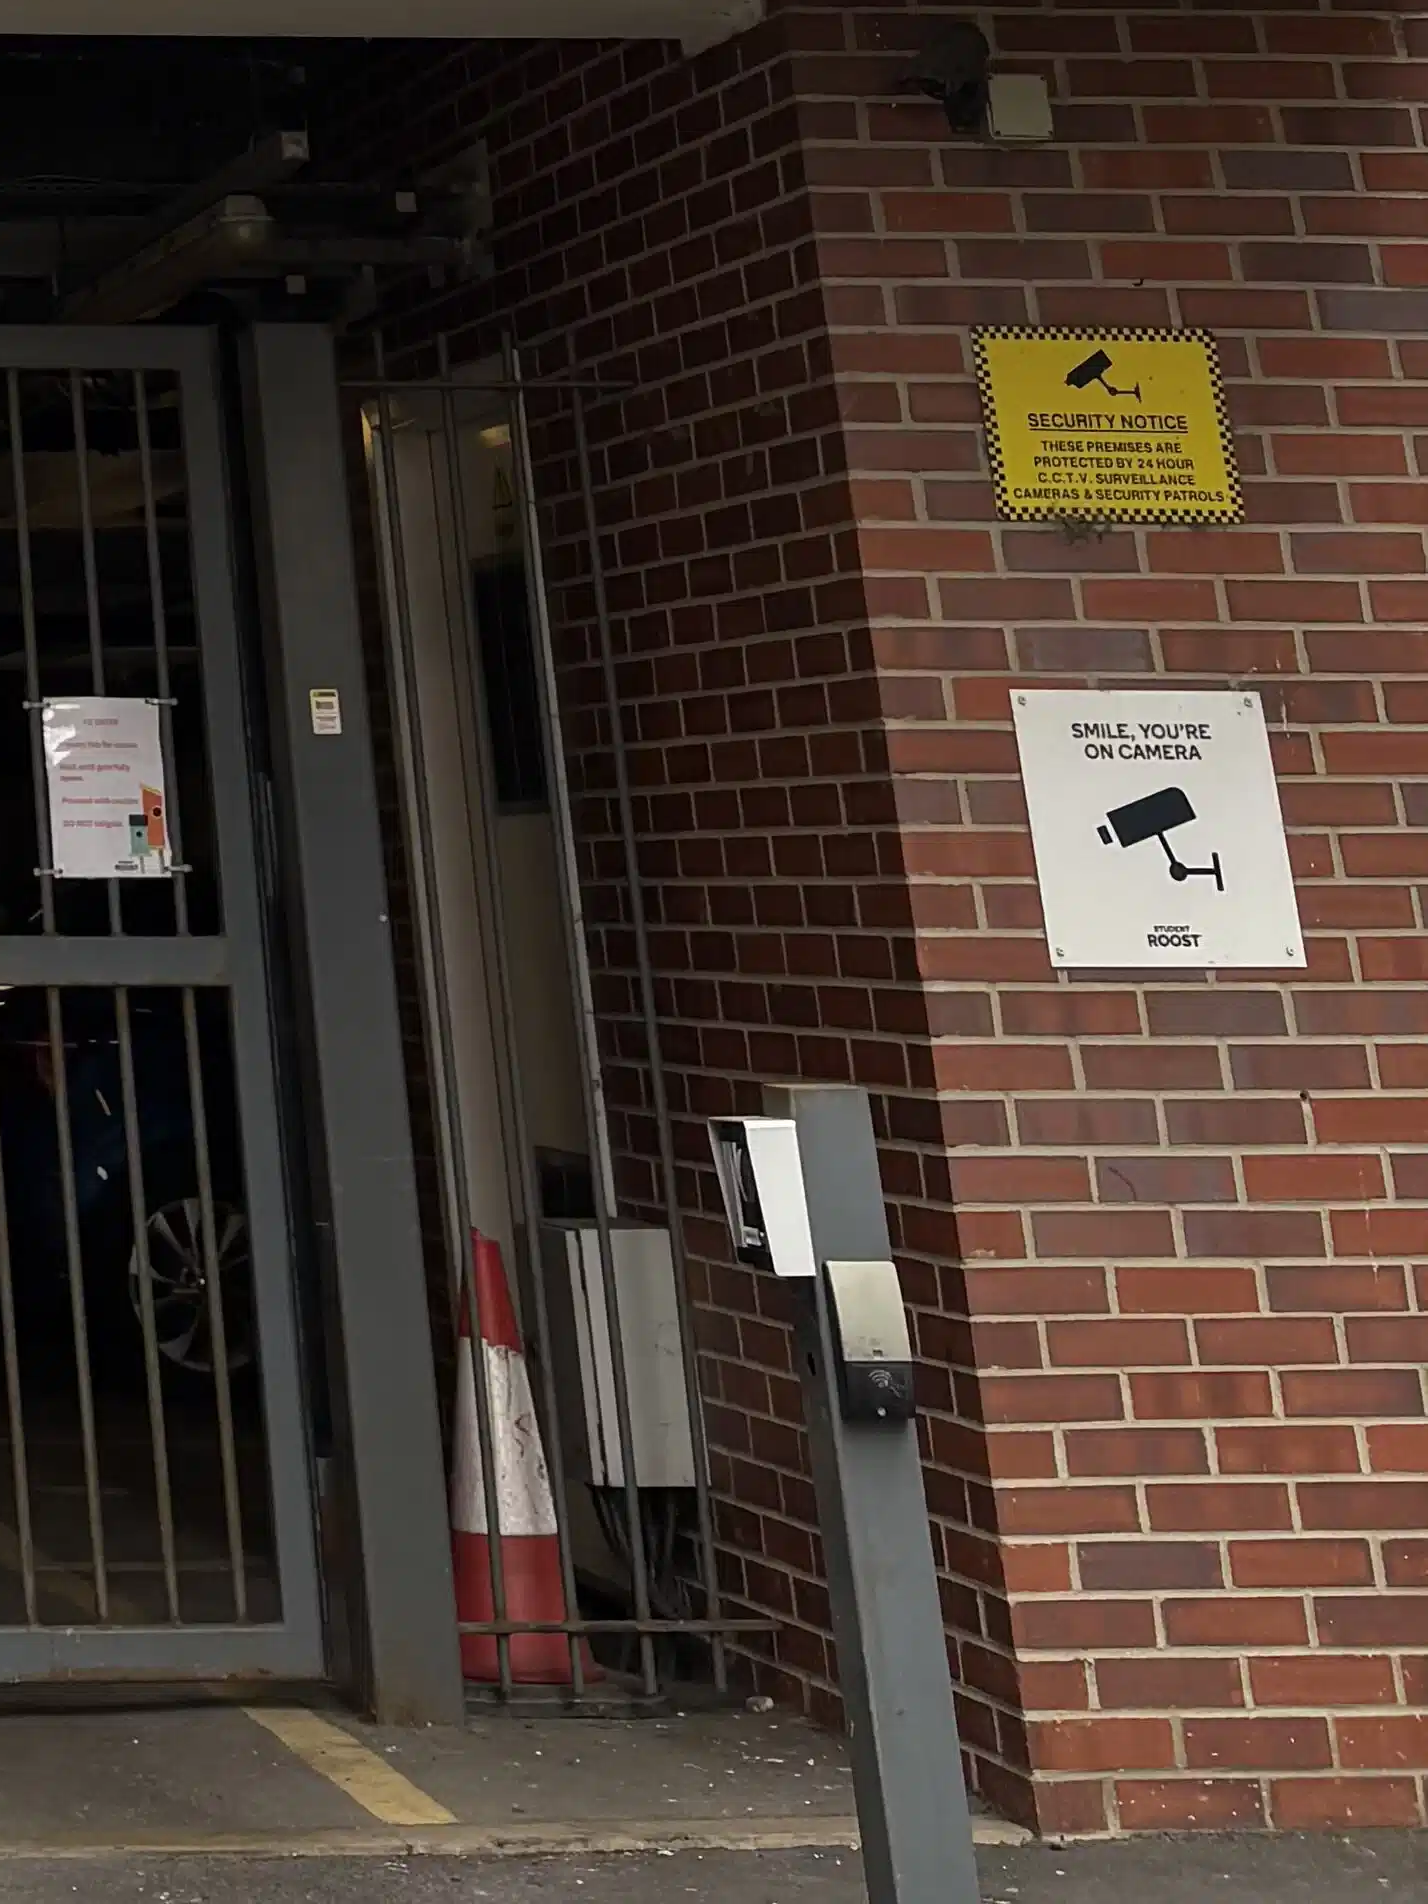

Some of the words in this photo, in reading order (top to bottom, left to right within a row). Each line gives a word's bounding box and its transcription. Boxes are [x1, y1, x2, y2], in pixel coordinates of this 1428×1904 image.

[1028, 413, 1115, 428] SECURITY
[1121, 415, 1188, 430] NOTICE
[1040, 440, 1084, 452] THESE
[1087, 441, 1152, 453] PREMISES
[1155, 442, 1182, 453] ARE
[1034, 456, 1113, 468] PROTECTED
[1116, 457, 1133, 469] BY
[1137, 458, 1154, 469] 24
[1157, 458, 1194, 470] HOUR
[1037, 472, 1093, 484] C.C.T.V.
[1095, 473, 1196, 486] SURVEILLANCE
[1013, 488, 1080, 500] CAMERAS
[1083, 489, 1093, 500] &
[1095, 489, 1160, 501] SECURITY
[1164, 490, 1225, 502] PATROLS
[1071, 723, 1136, 742] SMILE,
[1138, 723, 1212, 740] YOU'RE
[1084, 744, 1114, 760] ON
[1118, 744, 1202, 760] CAMERA
[1147, 934, 1203, 947] ROOST
